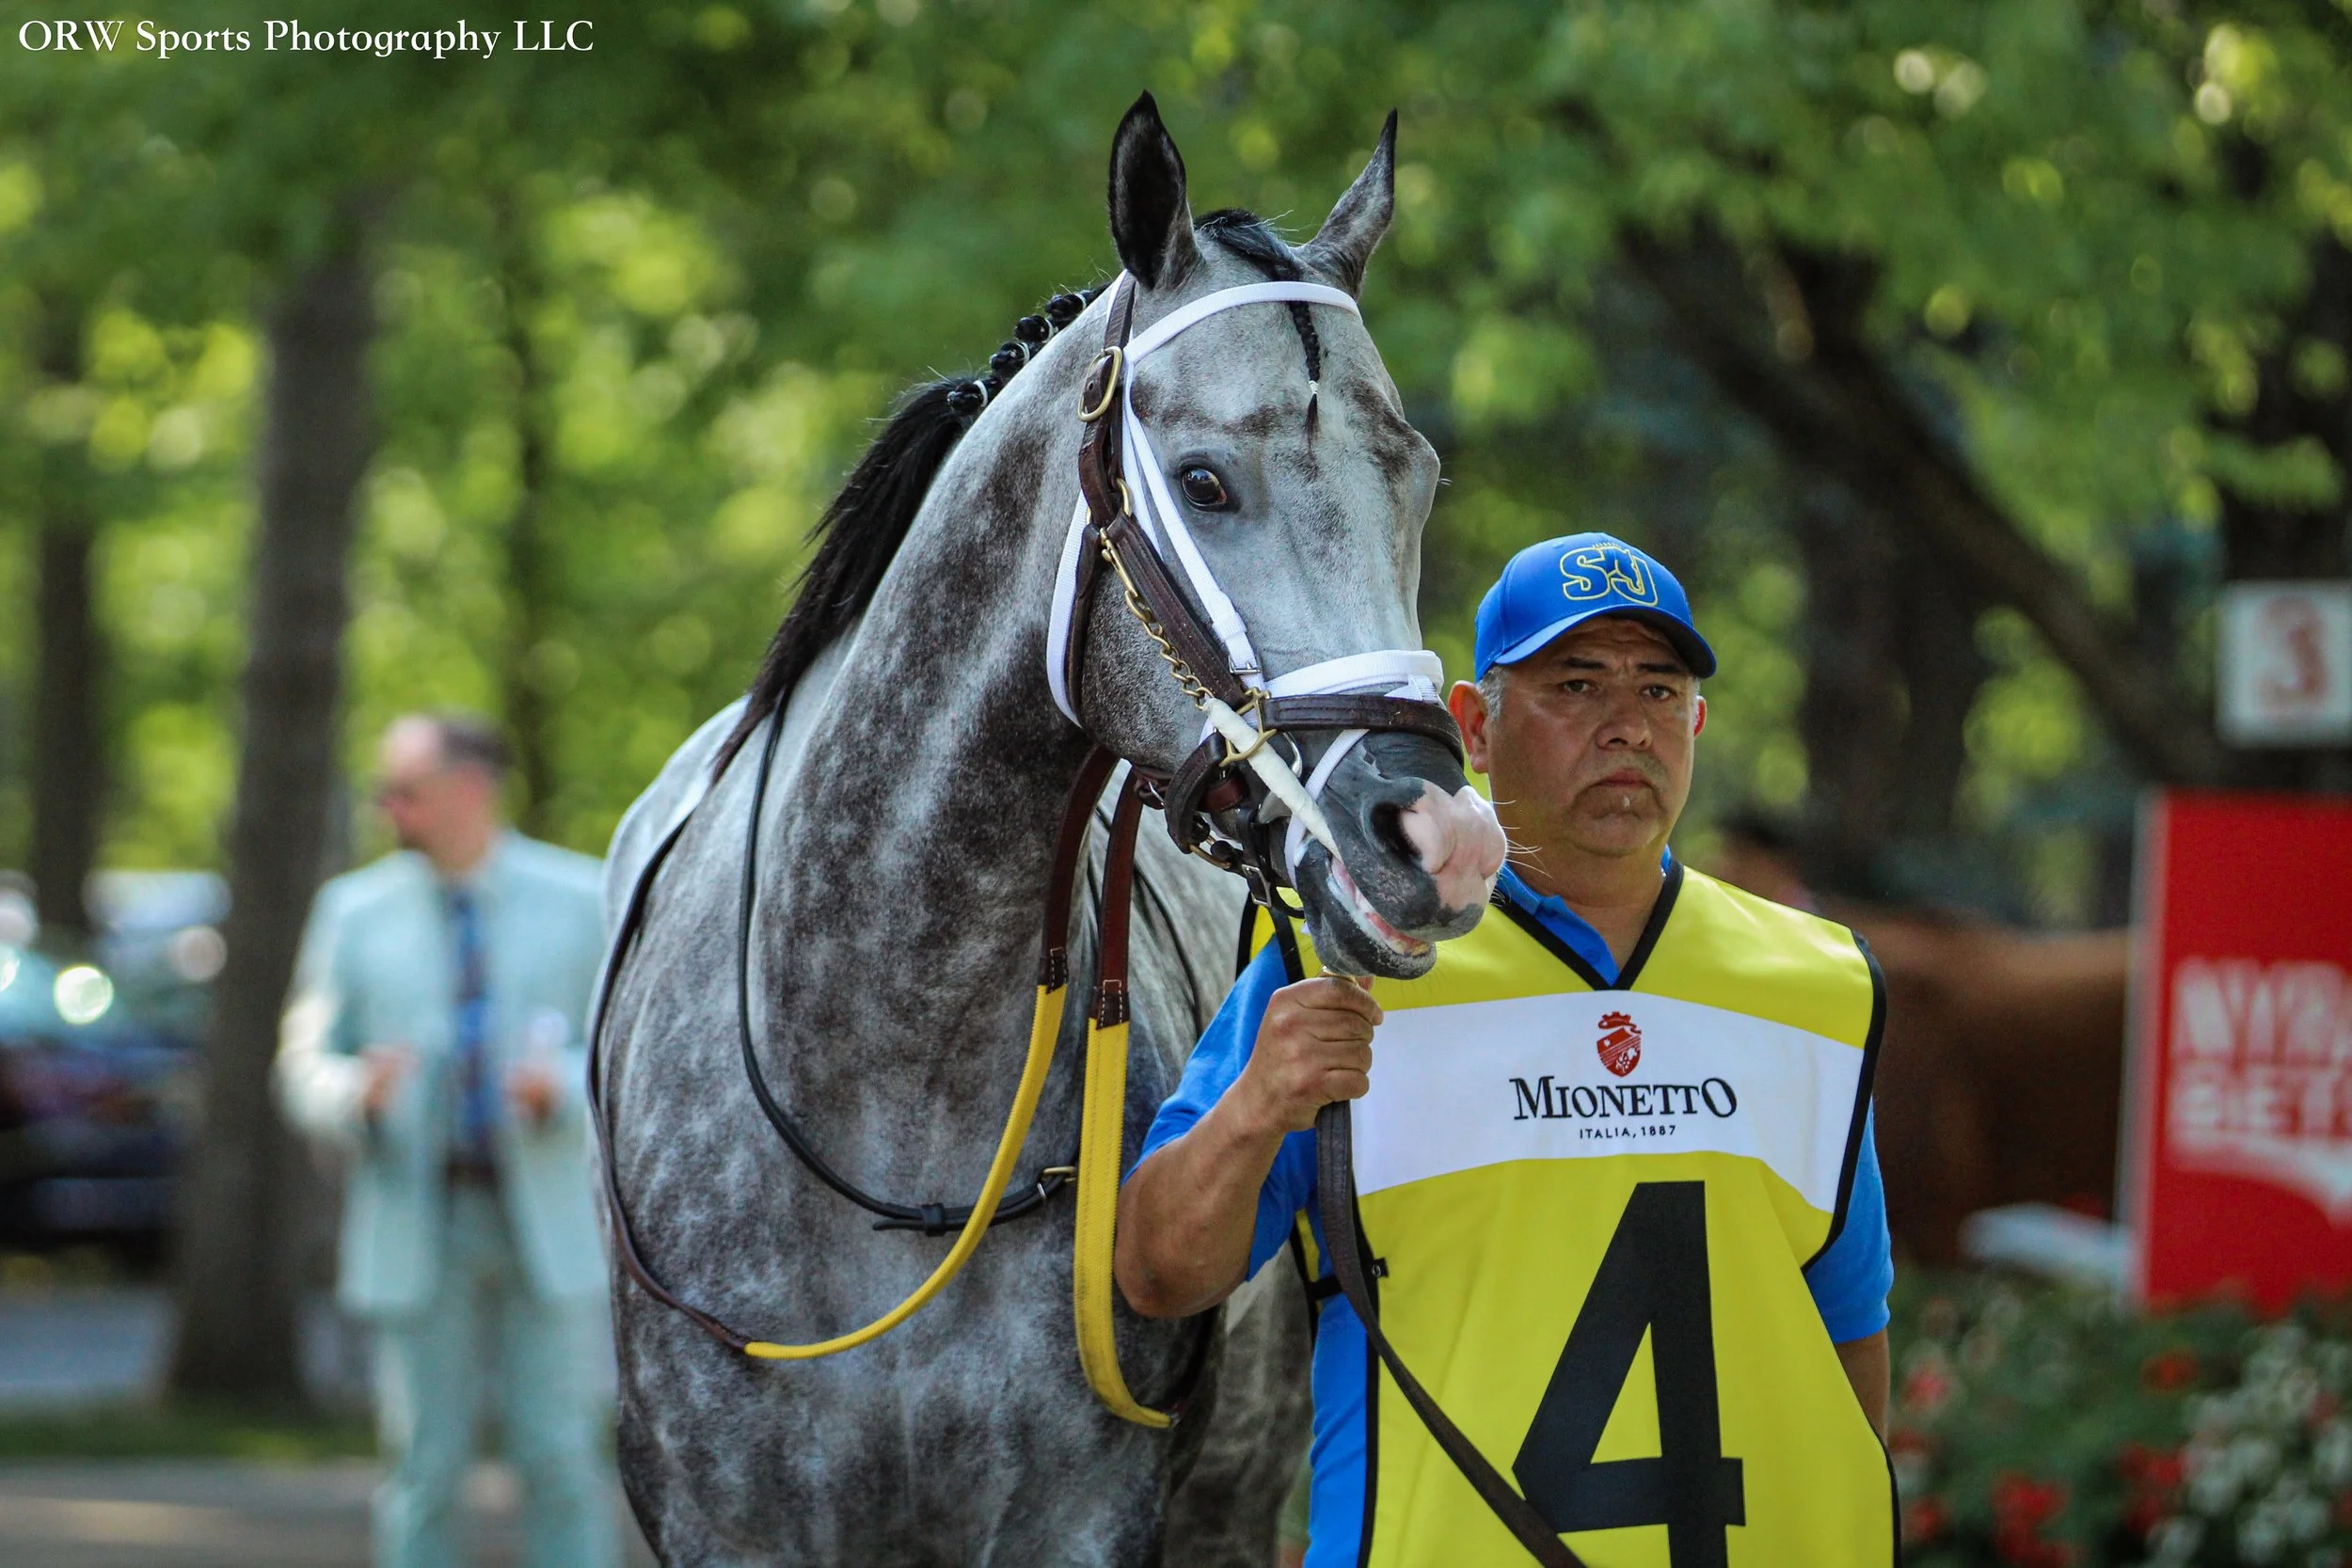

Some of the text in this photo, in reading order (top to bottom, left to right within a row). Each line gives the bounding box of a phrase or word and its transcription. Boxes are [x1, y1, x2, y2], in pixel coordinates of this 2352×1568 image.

[1560, 545, 1659, 607] SJ
[1640, 1124, 1677, 1136] 1887
[1511, 1180, 1746, 1568] 4
